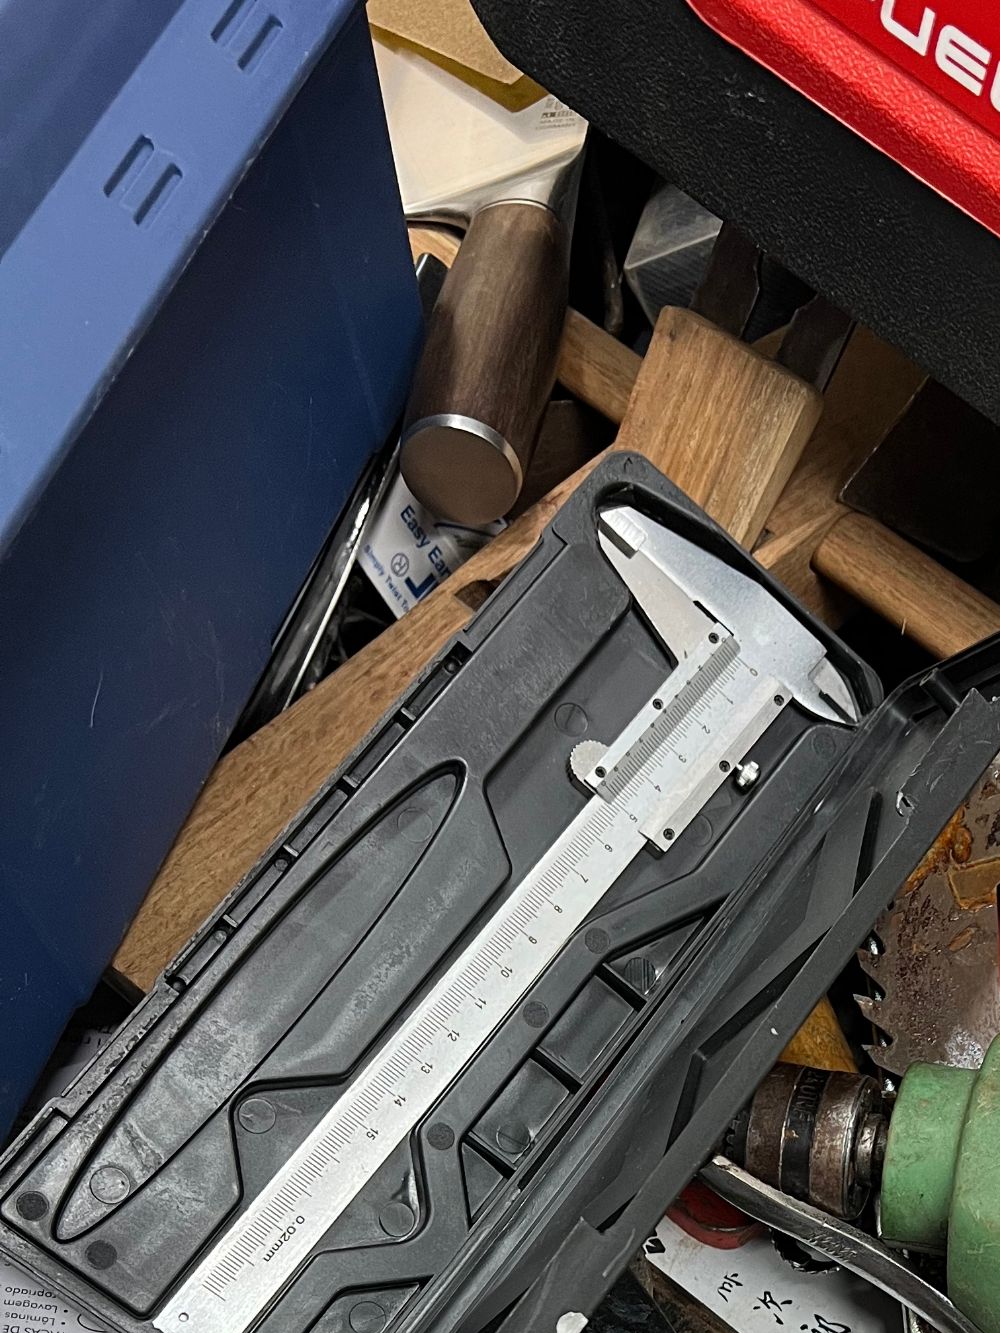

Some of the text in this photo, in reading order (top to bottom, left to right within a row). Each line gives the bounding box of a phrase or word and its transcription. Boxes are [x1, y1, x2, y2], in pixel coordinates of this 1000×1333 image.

[401, 504, 431, 548] Easy
[262, 1214, 306, 1263] 0.02mm
[3, 1299, 58, 1314] Lavagem
[4, 1311, 56, 1326] Lâminas
